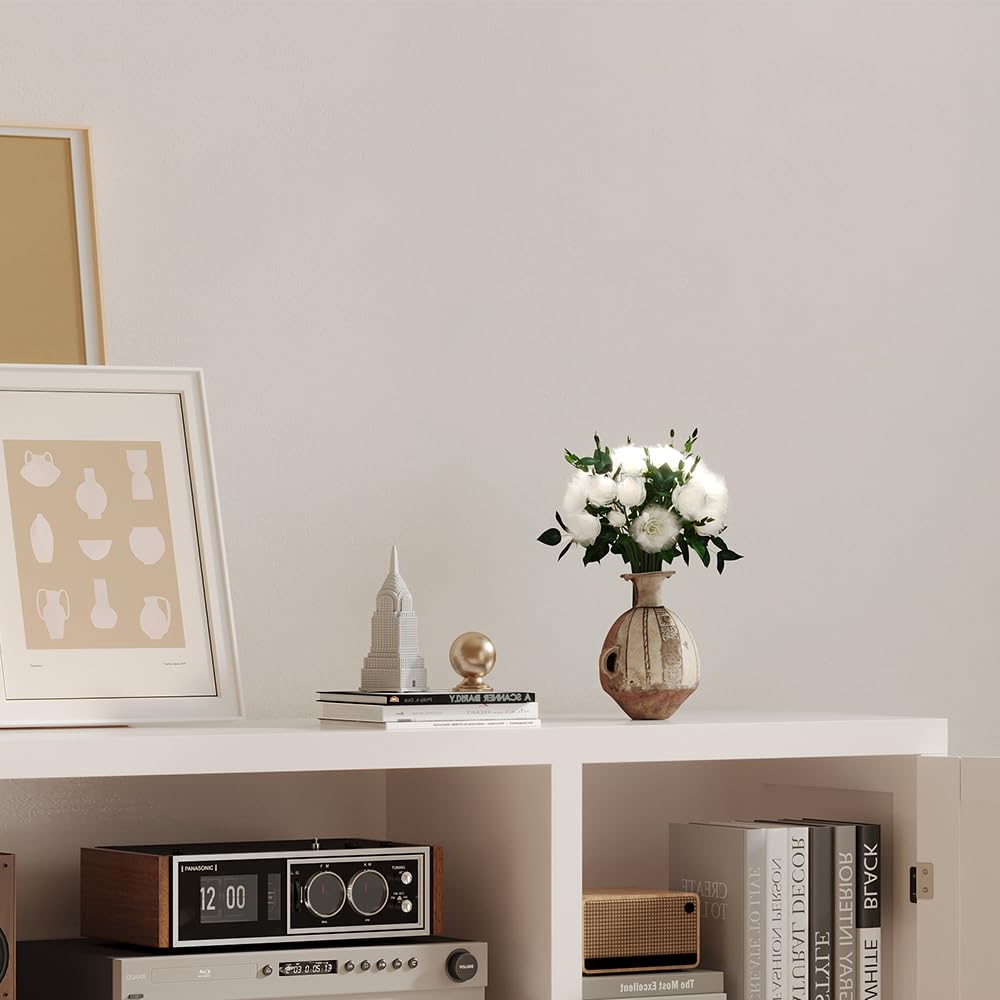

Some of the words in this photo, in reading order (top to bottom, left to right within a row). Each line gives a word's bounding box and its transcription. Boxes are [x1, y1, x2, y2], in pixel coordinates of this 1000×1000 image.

[184, 864, 214, 872] PANASONIC
[200, 886, 216, 911] 12
[226, 885, 246, 910] 00
